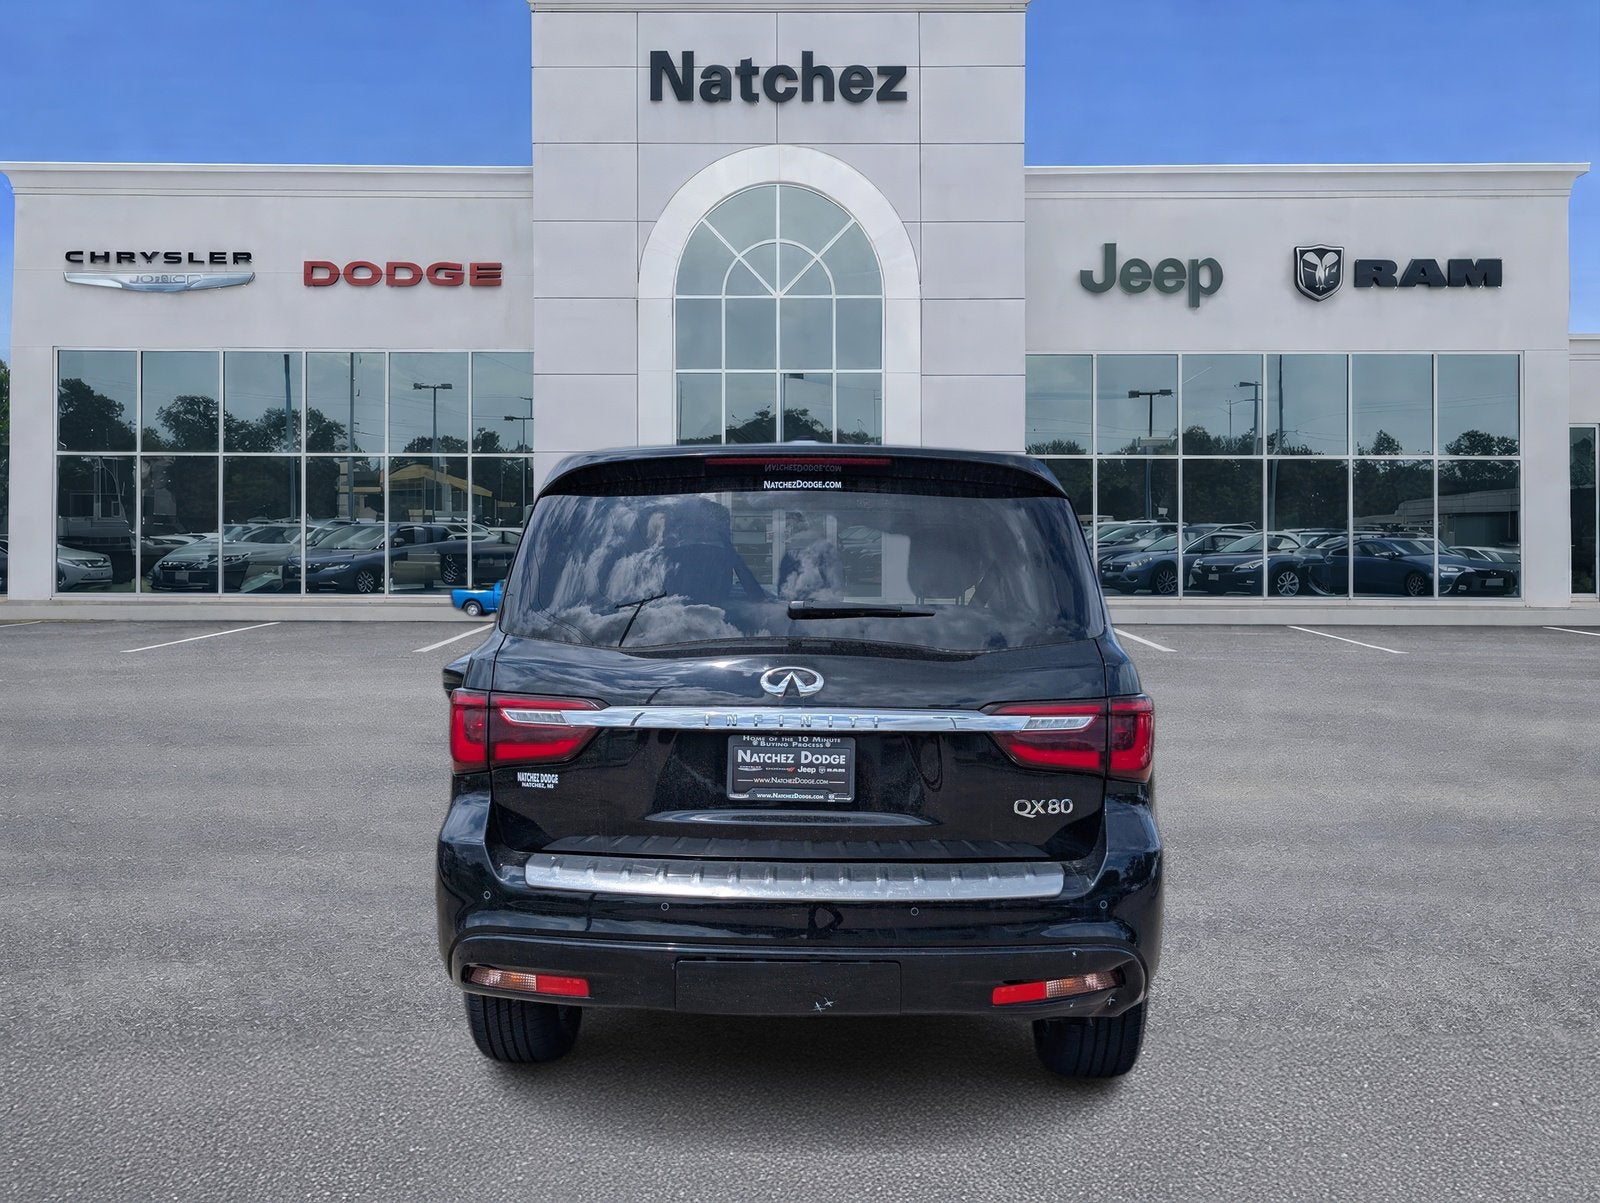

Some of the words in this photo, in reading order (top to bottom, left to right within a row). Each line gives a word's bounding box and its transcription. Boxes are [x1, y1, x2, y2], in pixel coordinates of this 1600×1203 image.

[650, 50, 908, 104] Natchez
[65, 251, 253, 265] CHRYSLER
[303, 261, 503, 287] DODGE
[1079, 243, 1223, 309] Jeep
[1354, 258, 1503, 288] RAM
[763, 480, 842, 489] NATCHEZDODGE.COM
[704, 714, 879, 728] INFINITI
[737, 750, 794, 763] NATCHEZ
[800, 751, 846, 764] DODGE
[517, 771, 540, 782] NATCHEZ
[540, 773, 559, 783] DODGE
[1013, 798, 1074, 818] QX80
